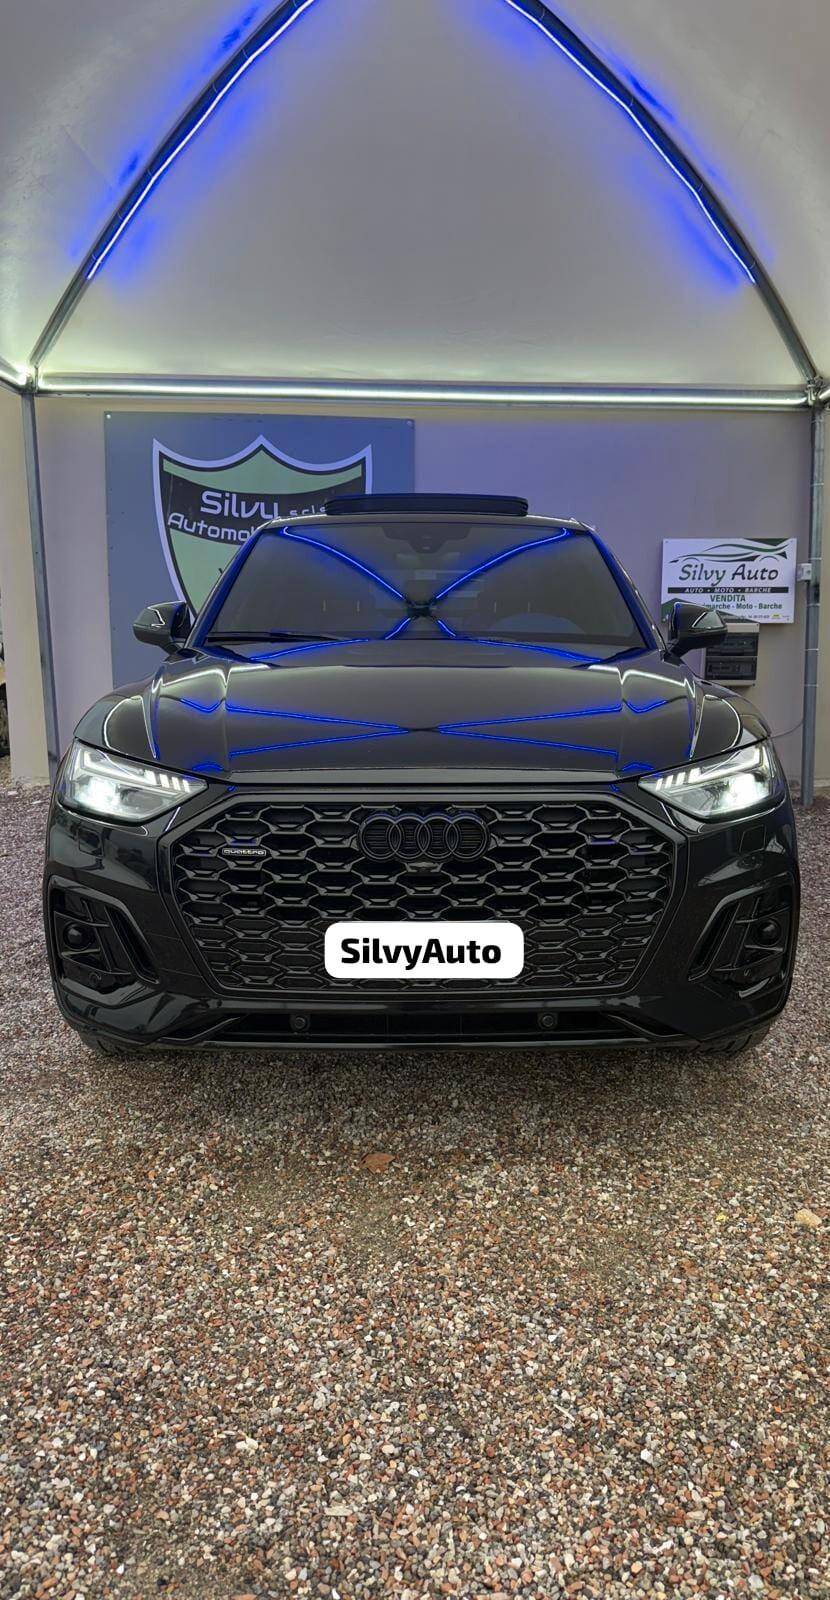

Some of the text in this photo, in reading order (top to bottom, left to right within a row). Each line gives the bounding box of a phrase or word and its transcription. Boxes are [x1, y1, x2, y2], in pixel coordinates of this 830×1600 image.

[200, 490, 279, 520] Silvy
[678, 563, 779, 587] Silvy Auto
[710, 594, 746, 602] VENDITA
[736, 602, 754, 610] Moto
[758, 602, 783, 610] Barche
